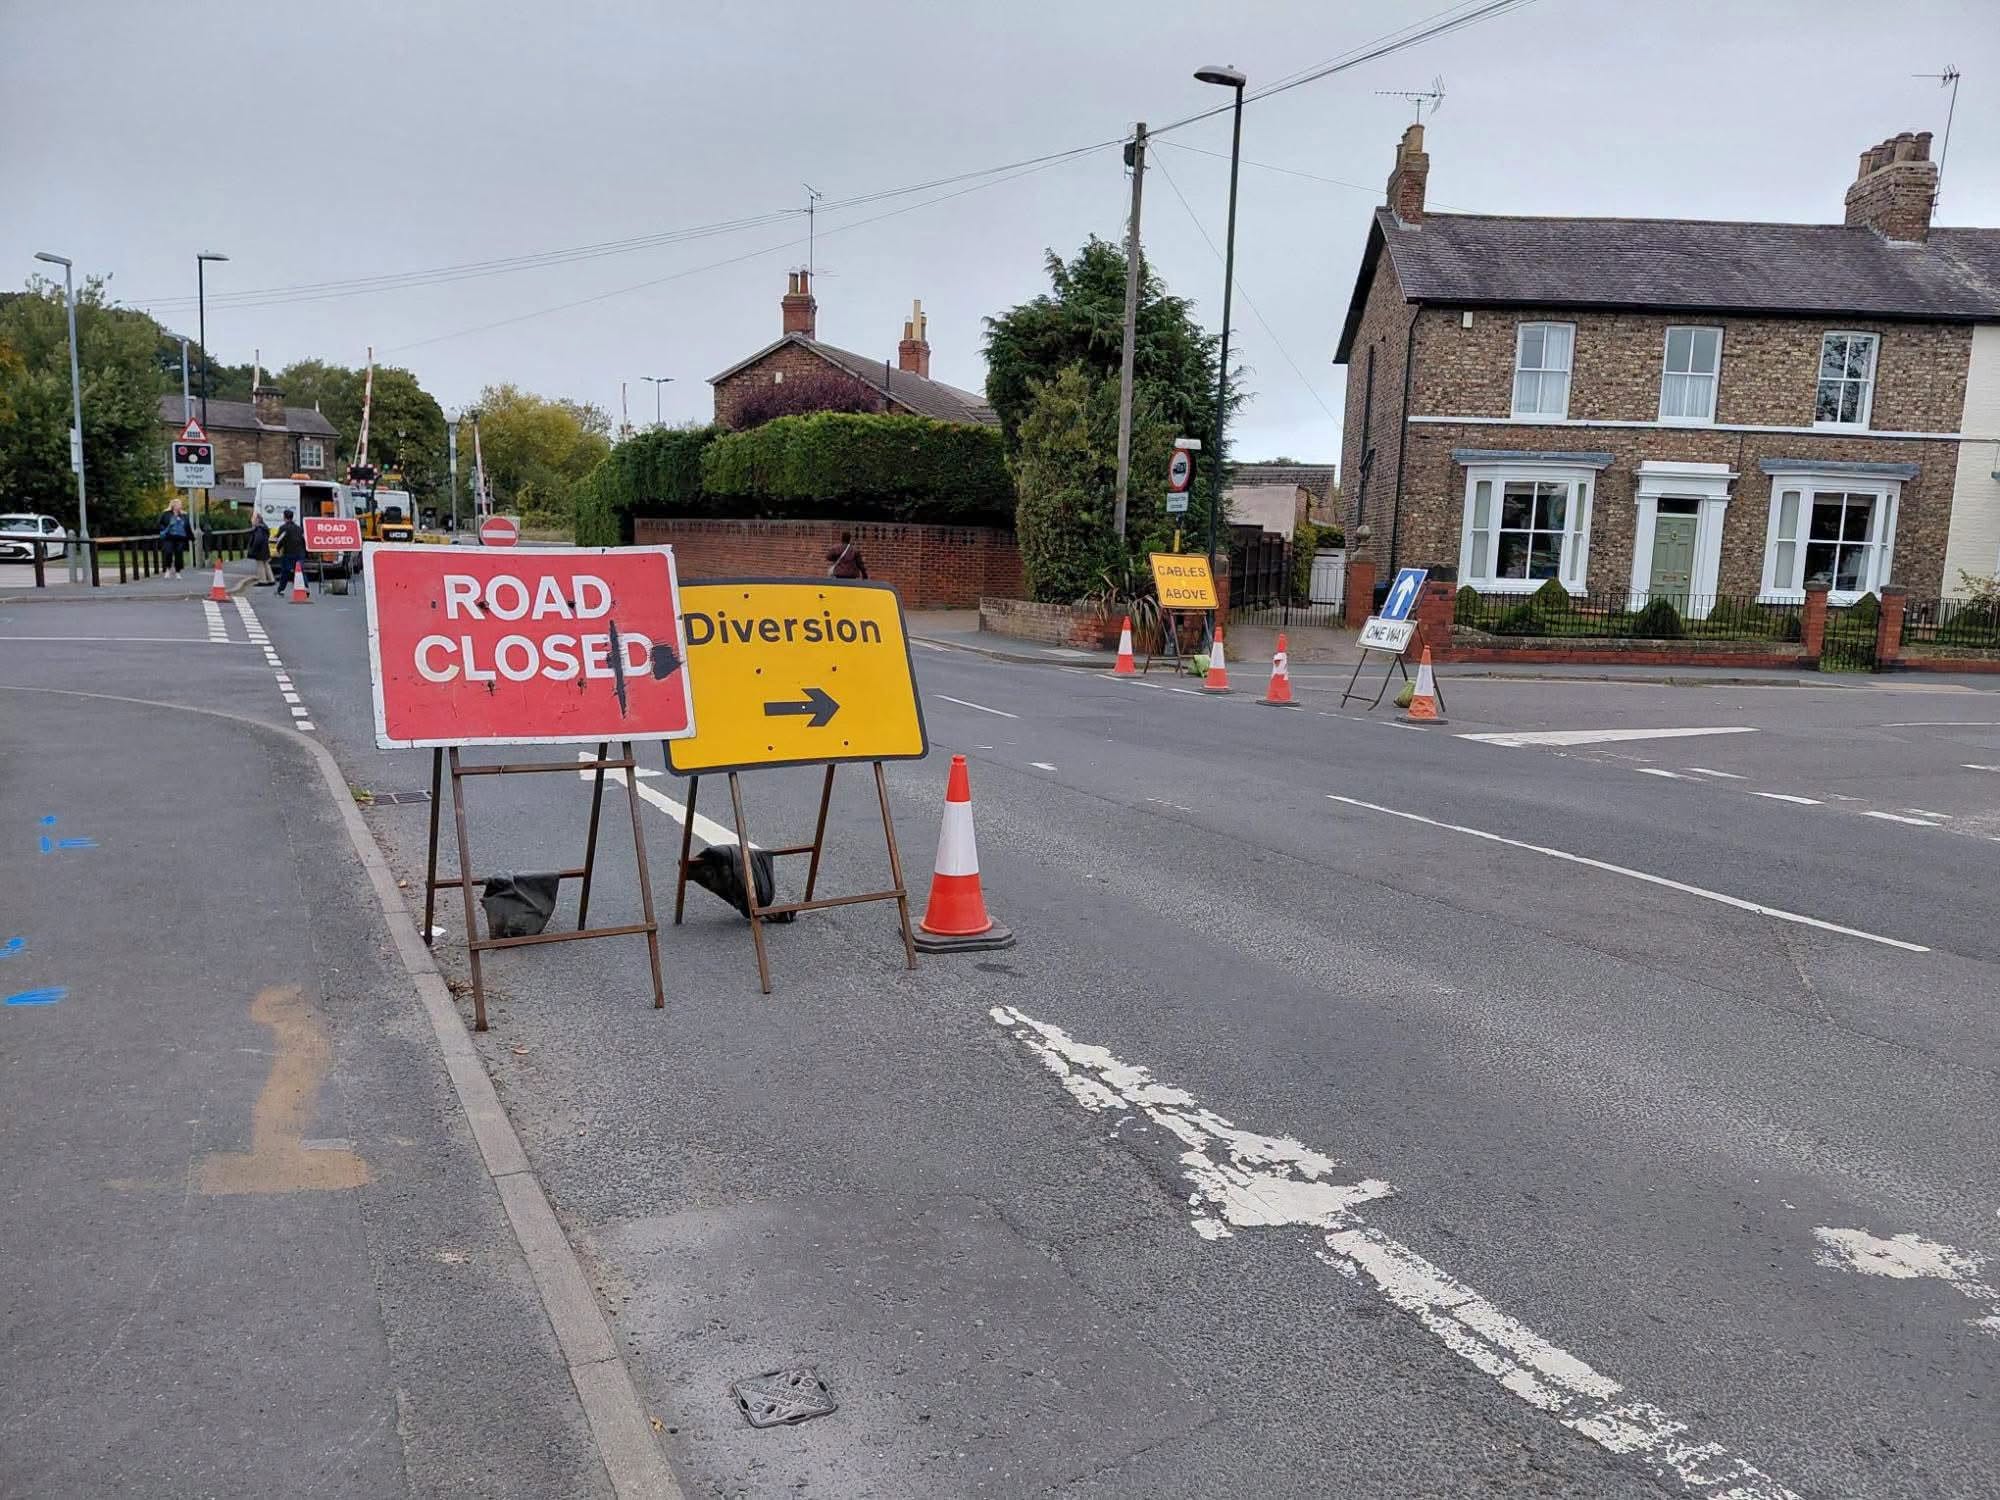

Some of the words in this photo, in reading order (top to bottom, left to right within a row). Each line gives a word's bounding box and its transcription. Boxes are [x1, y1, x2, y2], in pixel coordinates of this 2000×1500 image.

[317, 523, 347, 533] ROAD
[313, 536, 354, 545] CLOSED
[1157, 565, 1207, 578] CABLES
[443, 574, 612, 621] ROAD
[1166, 587, 1208, 600] ABOVE
[683, 611, 882, 646] Diversion
[1366, 625, 1387, 640] ONE
[1386, 626, 1408, 643] WAY
[414, 632, 654, 683] CLOSED
